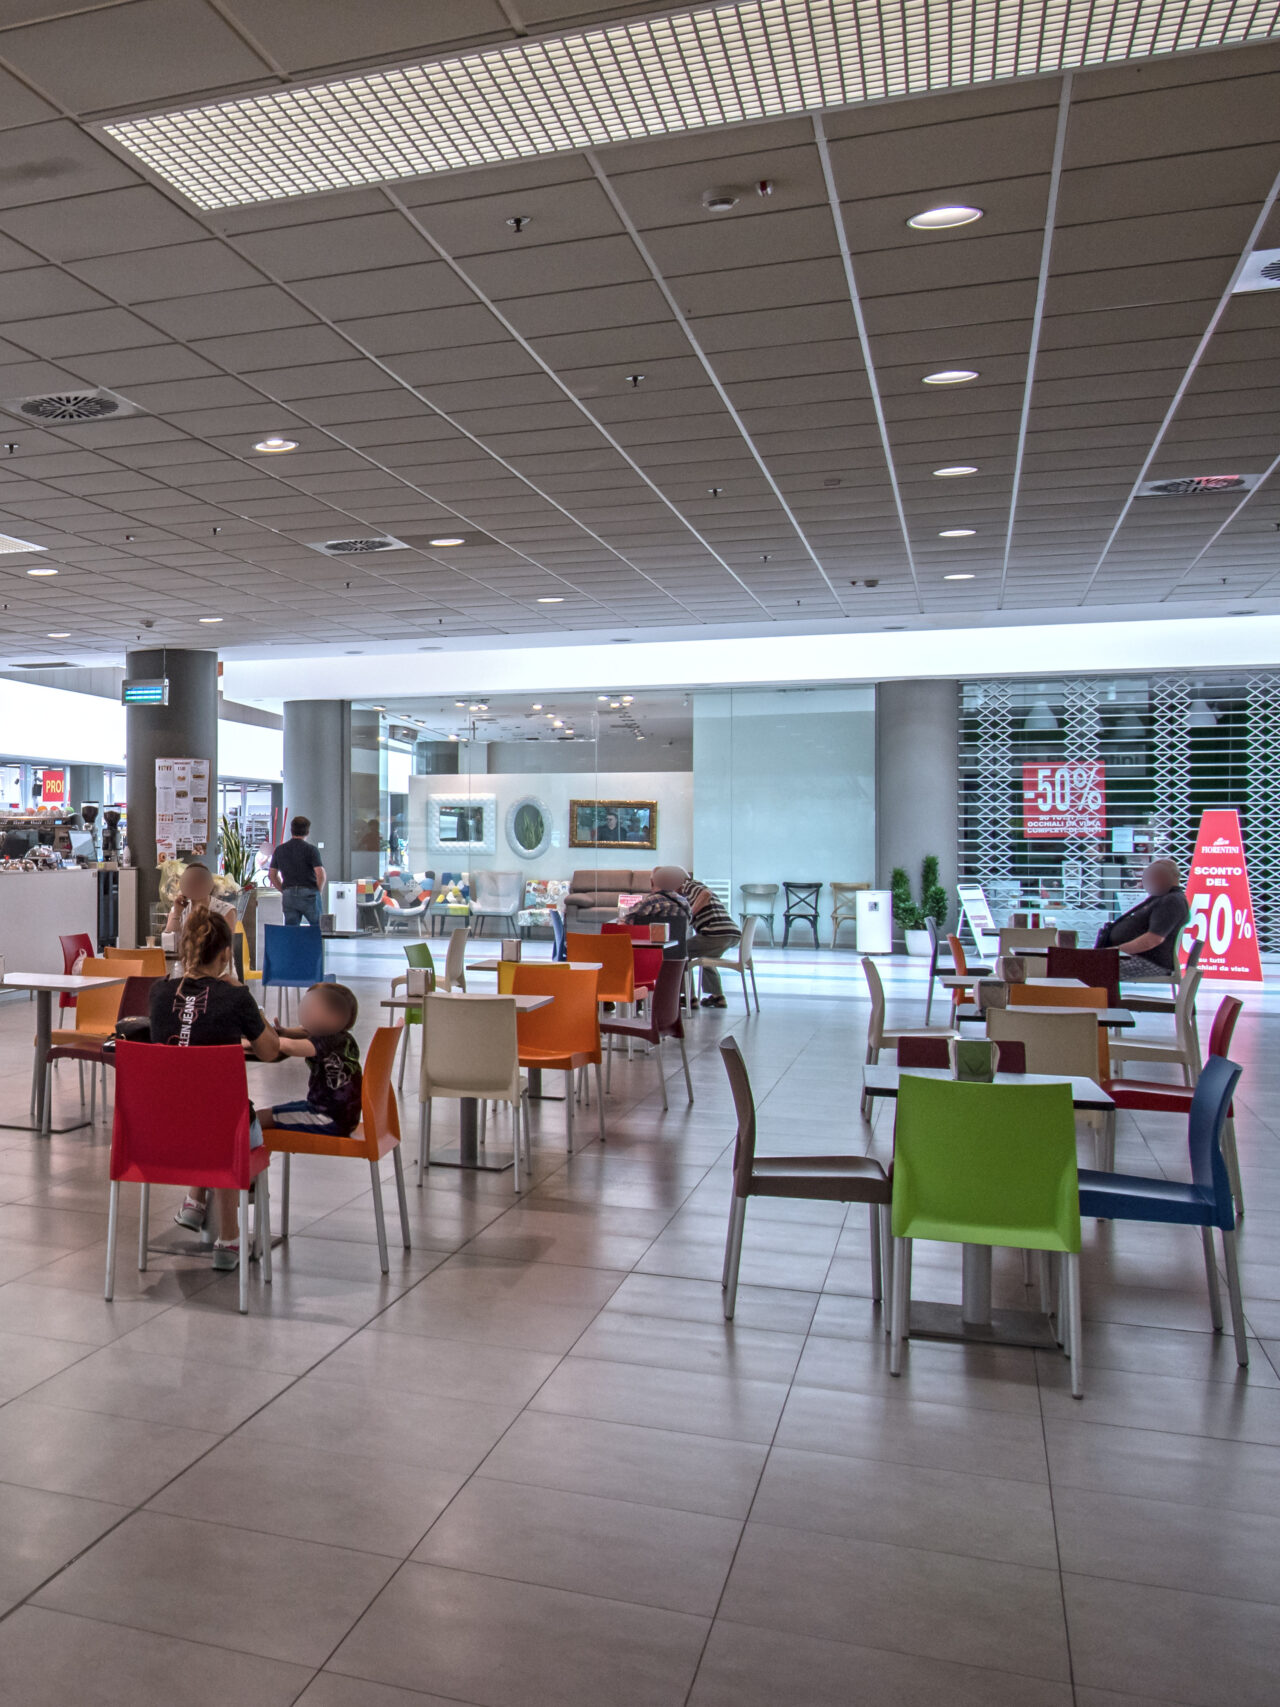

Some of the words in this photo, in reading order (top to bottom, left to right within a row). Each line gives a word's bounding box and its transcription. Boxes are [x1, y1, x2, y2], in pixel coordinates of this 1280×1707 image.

[1024, 767, 1101, 811] -50%
[1201, 846, 1239, 854] FIORENTINI
[1194, 866, 1242, 876] SCONTO
[1206, 878, 1229, 887] DEL
[183, 996, 196, 1025] JEANS
